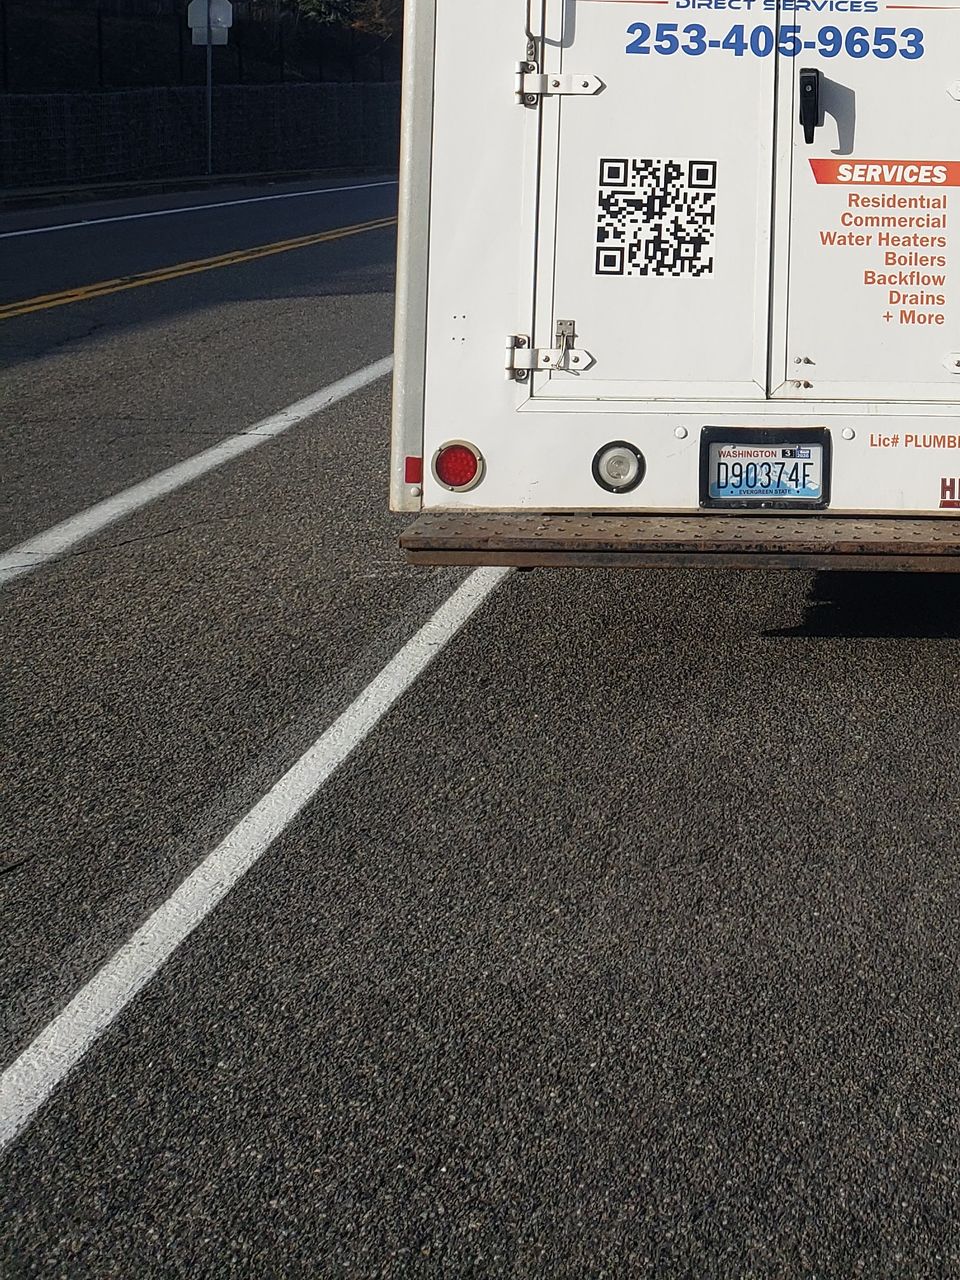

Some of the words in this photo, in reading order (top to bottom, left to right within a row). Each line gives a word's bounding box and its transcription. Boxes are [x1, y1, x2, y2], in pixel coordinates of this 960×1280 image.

[625, 22, 925, 60] 253-405-9653
[836, 164, 948, 183] SERVICES
[848, 193, 947, 209] Residential
[841, 212, 947, 228] Commercial
[820, 231, 872, 246] Water
[878, 232, 947, 248] Heaters
[884, 252, 946, 267] Boilers
[864, 271, 946, 286] Backflow
[889, 290, 946, 305] Drains
[882, 311, 893, 322] +
[899, 310, 945, 325] More
[870, 434, 900, 448] Lic#
[718, 450, 777, 458] WASHINGTON
[717, 462, 814, 489] D90374F
